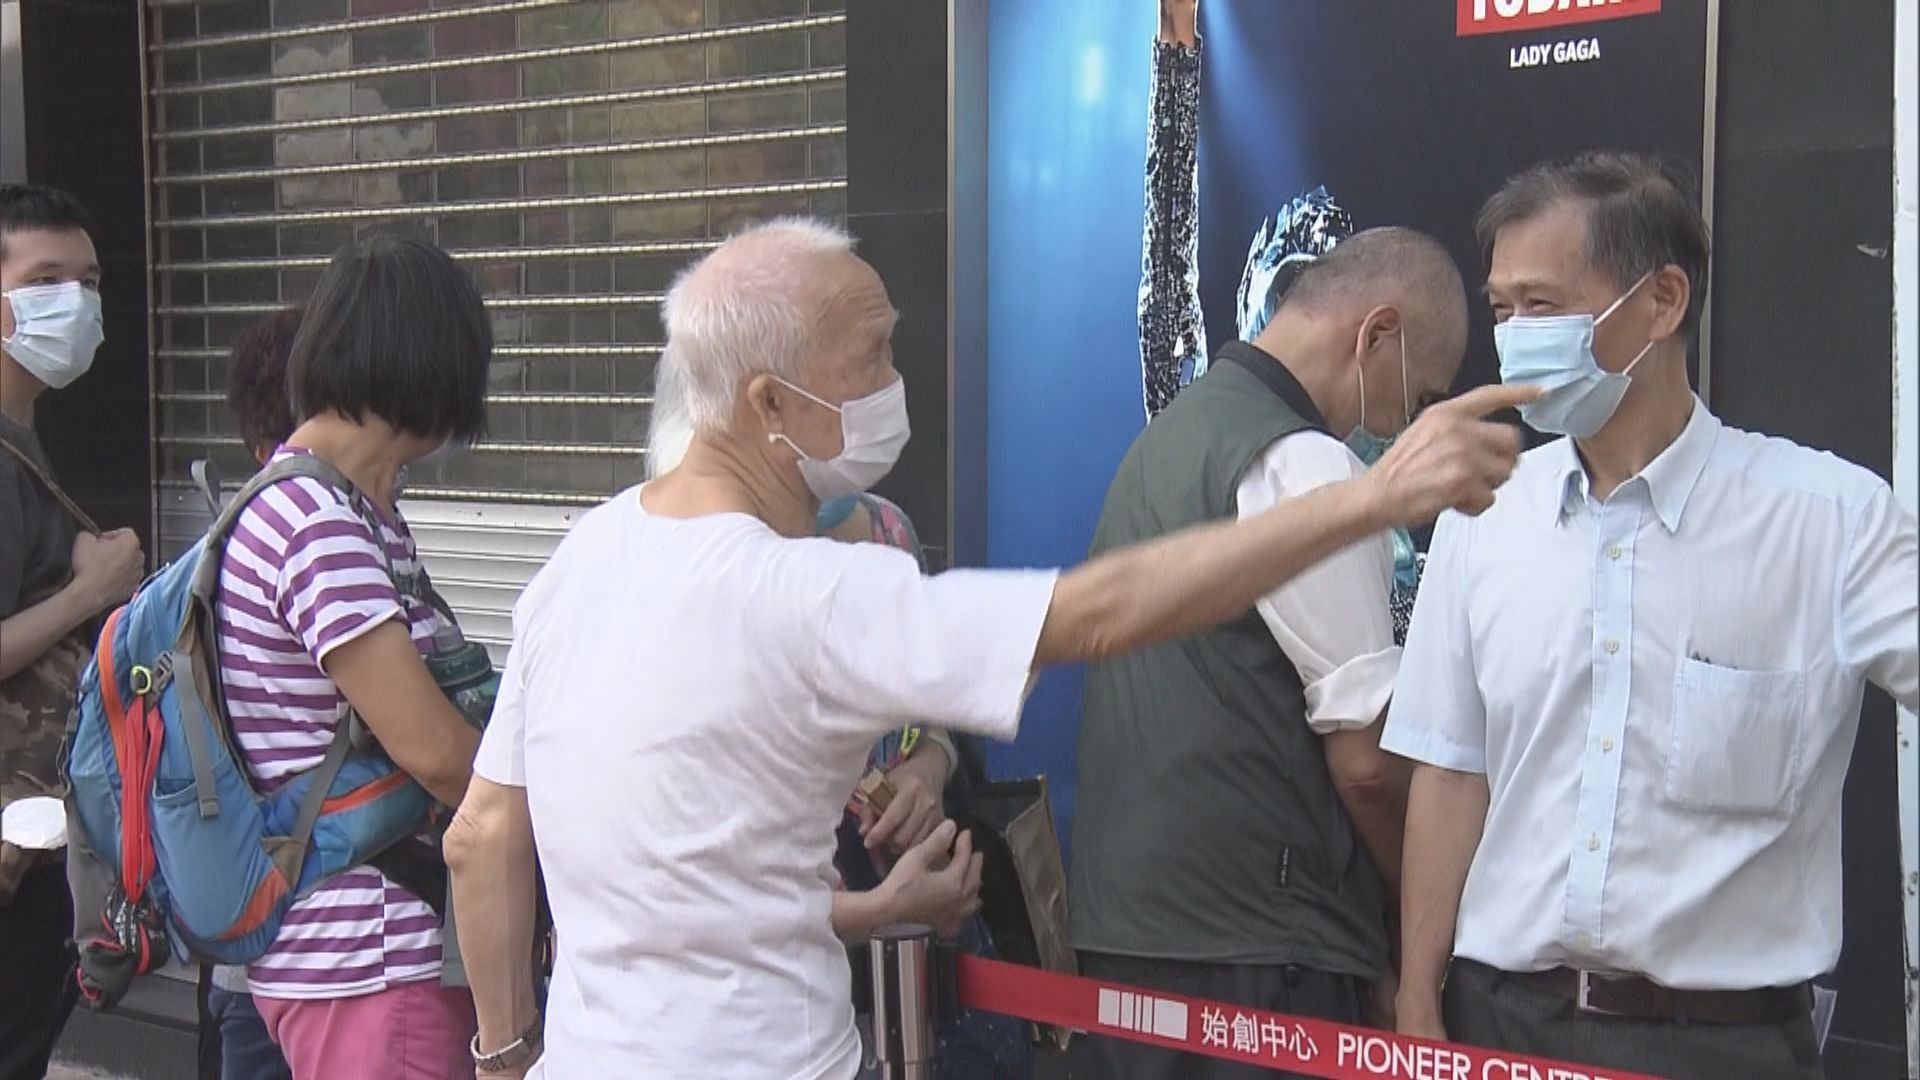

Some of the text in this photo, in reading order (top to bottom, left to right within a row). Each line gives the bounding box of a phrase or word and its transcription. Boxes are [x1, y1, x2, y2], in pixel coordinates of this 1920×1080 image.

[1510, 37, 1601, 68] LADY GAGA
[1200, 1005, 1319, 1061] 始創中心
[1337, 1032, 1473, 1080] PIONEER
